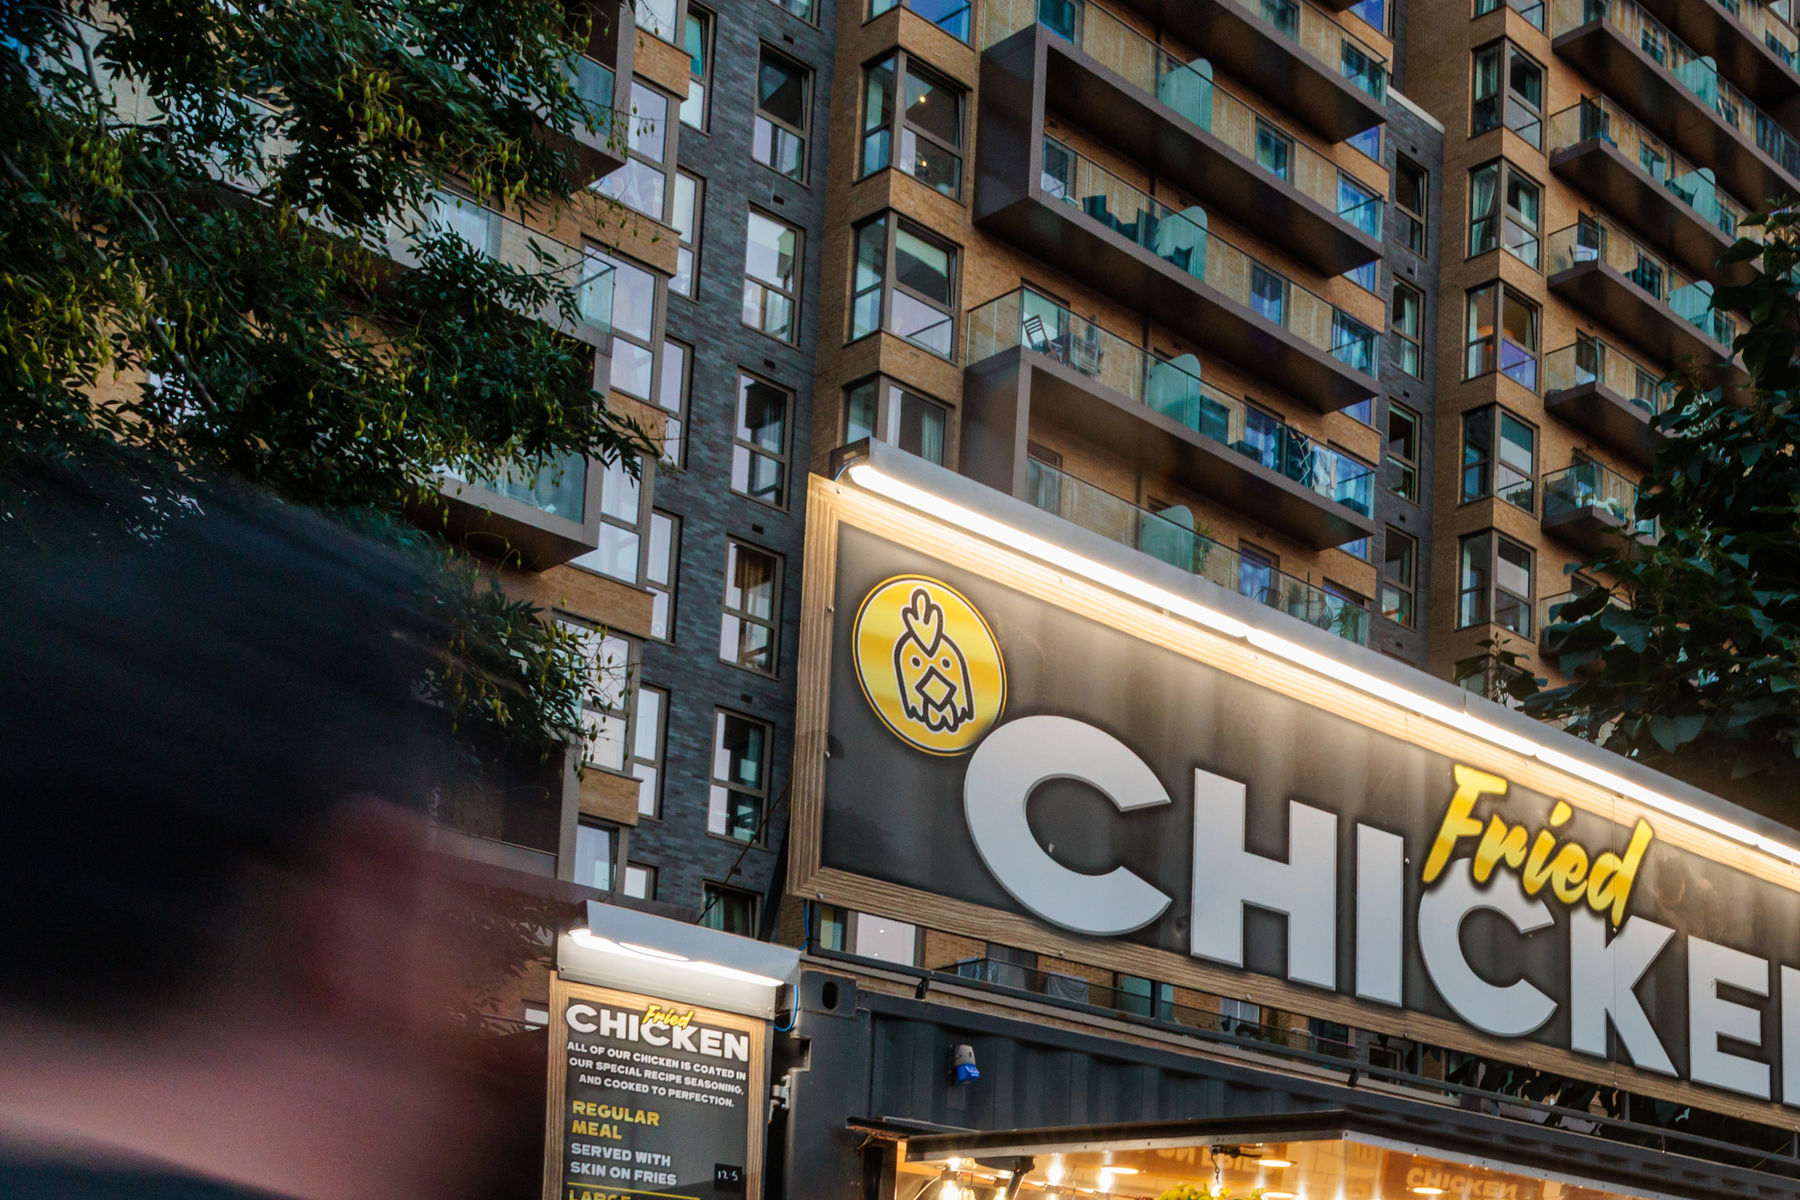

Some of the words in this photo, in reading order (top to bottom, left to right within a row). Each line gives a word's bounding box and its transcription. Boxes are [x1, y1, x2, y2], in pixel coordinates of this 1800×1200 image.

[1421, 764, 1656, 930] Fried
[642, 1003, 695, 1030] Fried
[565, 1003, 749, 1062] CHICKEN
[567, 1041, 588, 1054] ALL
[589, 1045, 605, 1056] OF
[607, 1048, 631, 1061] OUR
[632, 1052, 680, 1070] CHICKEN
[680, 1060, 692, 1071] IS
[693, 1063, 735, 1079] COATED
[736, 1071, 747, 1081] IN
[569, 1057, 594, 1069] OUR
[595, 1061, 643, 1078] SPECIAL
[643, 1069, 682, 1084] RECIPE
[684, 1076, 745, 1096] SEASONING,
[579, 1074, 602, 1086] AND
[603, 1077, 650, 1094] COOKED
[651, 1086, 667, 1097] TO
[668, 1089, 735, 1108] PERFECTION.
[572, 1100, 660, 1127] REGULAR
[571, 1119, 623, 1140] MEAL
[570, 1142, 632, 1161] SERVED
[635, 1151, 672, 1167] WITH
[570, 1161, 607, 1177] SKIN
[609, 1166, 632, 1180] ON
[634, 1169, 677, 1186] FRIES
